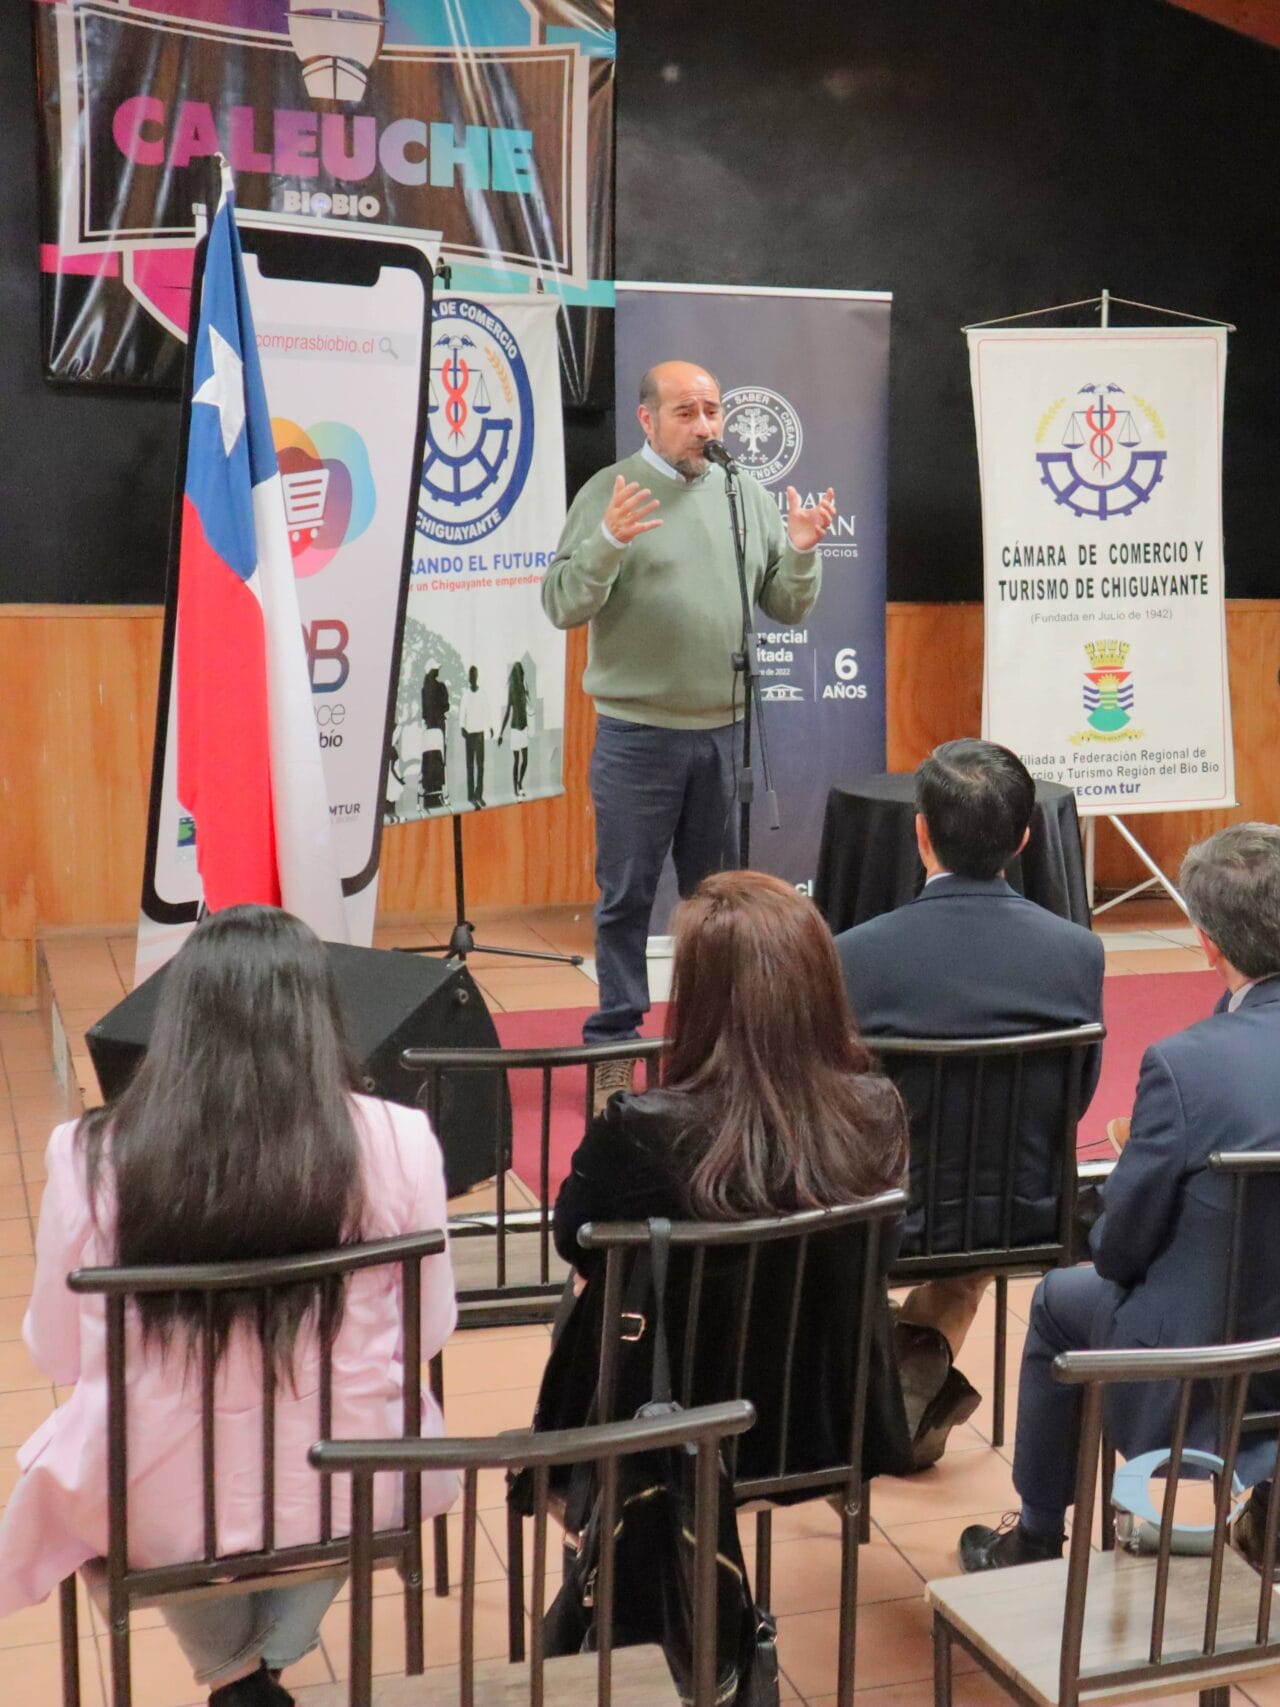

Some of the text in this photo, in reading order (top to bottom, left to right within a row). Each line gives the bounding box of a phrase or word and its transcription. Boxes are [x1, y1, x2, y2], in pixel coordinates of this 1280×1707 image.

[112, 96, 533, 194] CALEUCHE
[283, 190, 380, 218] BIOBIO
[440, 302, 517, 358] DE COMERCIO
[255, 334, 374, 354] comprasbiobio.cl
[734, 392, 769, 404] SABER
[781, 412, 795, 447] CREAR
[745, 461, 782, 478] ENDER
[469, 555, 488, 572] EL
[1002, 540, 1203, 568] CÁMARA DE COMERCIO Y
[416, 582, 428, 592] un
[431, 577, 492, 592] Chiguayante
[496, 574, 545, 588] emprende
[998, 574, 1208, 601] TURISMO DE CHIGUAYANTE
[1030, 613, 1079, 624] (Fundada
[1082, 613, 1095, 621] en
[1128, 610, 1141, 620] de
[1145, 608, 1173, 620] 1942)
[757, 629, 808, 644] ercial
[301, 619, 349, 694] B
[757, 648, 793, 662] itada
[834, 648, 859, 680] 6
[822, 682, 868, 700] AÑOS
[314, 703, 346, 726] ce
[1020, 747, 1206, 765] filiada a Federación Regional de
[1057, 771, 1064, 782] y
[1067, 768, 1112, 779] Turismo
[1117, 765, 1155, 779] Región
[1159, 763, 1176, 775] del
